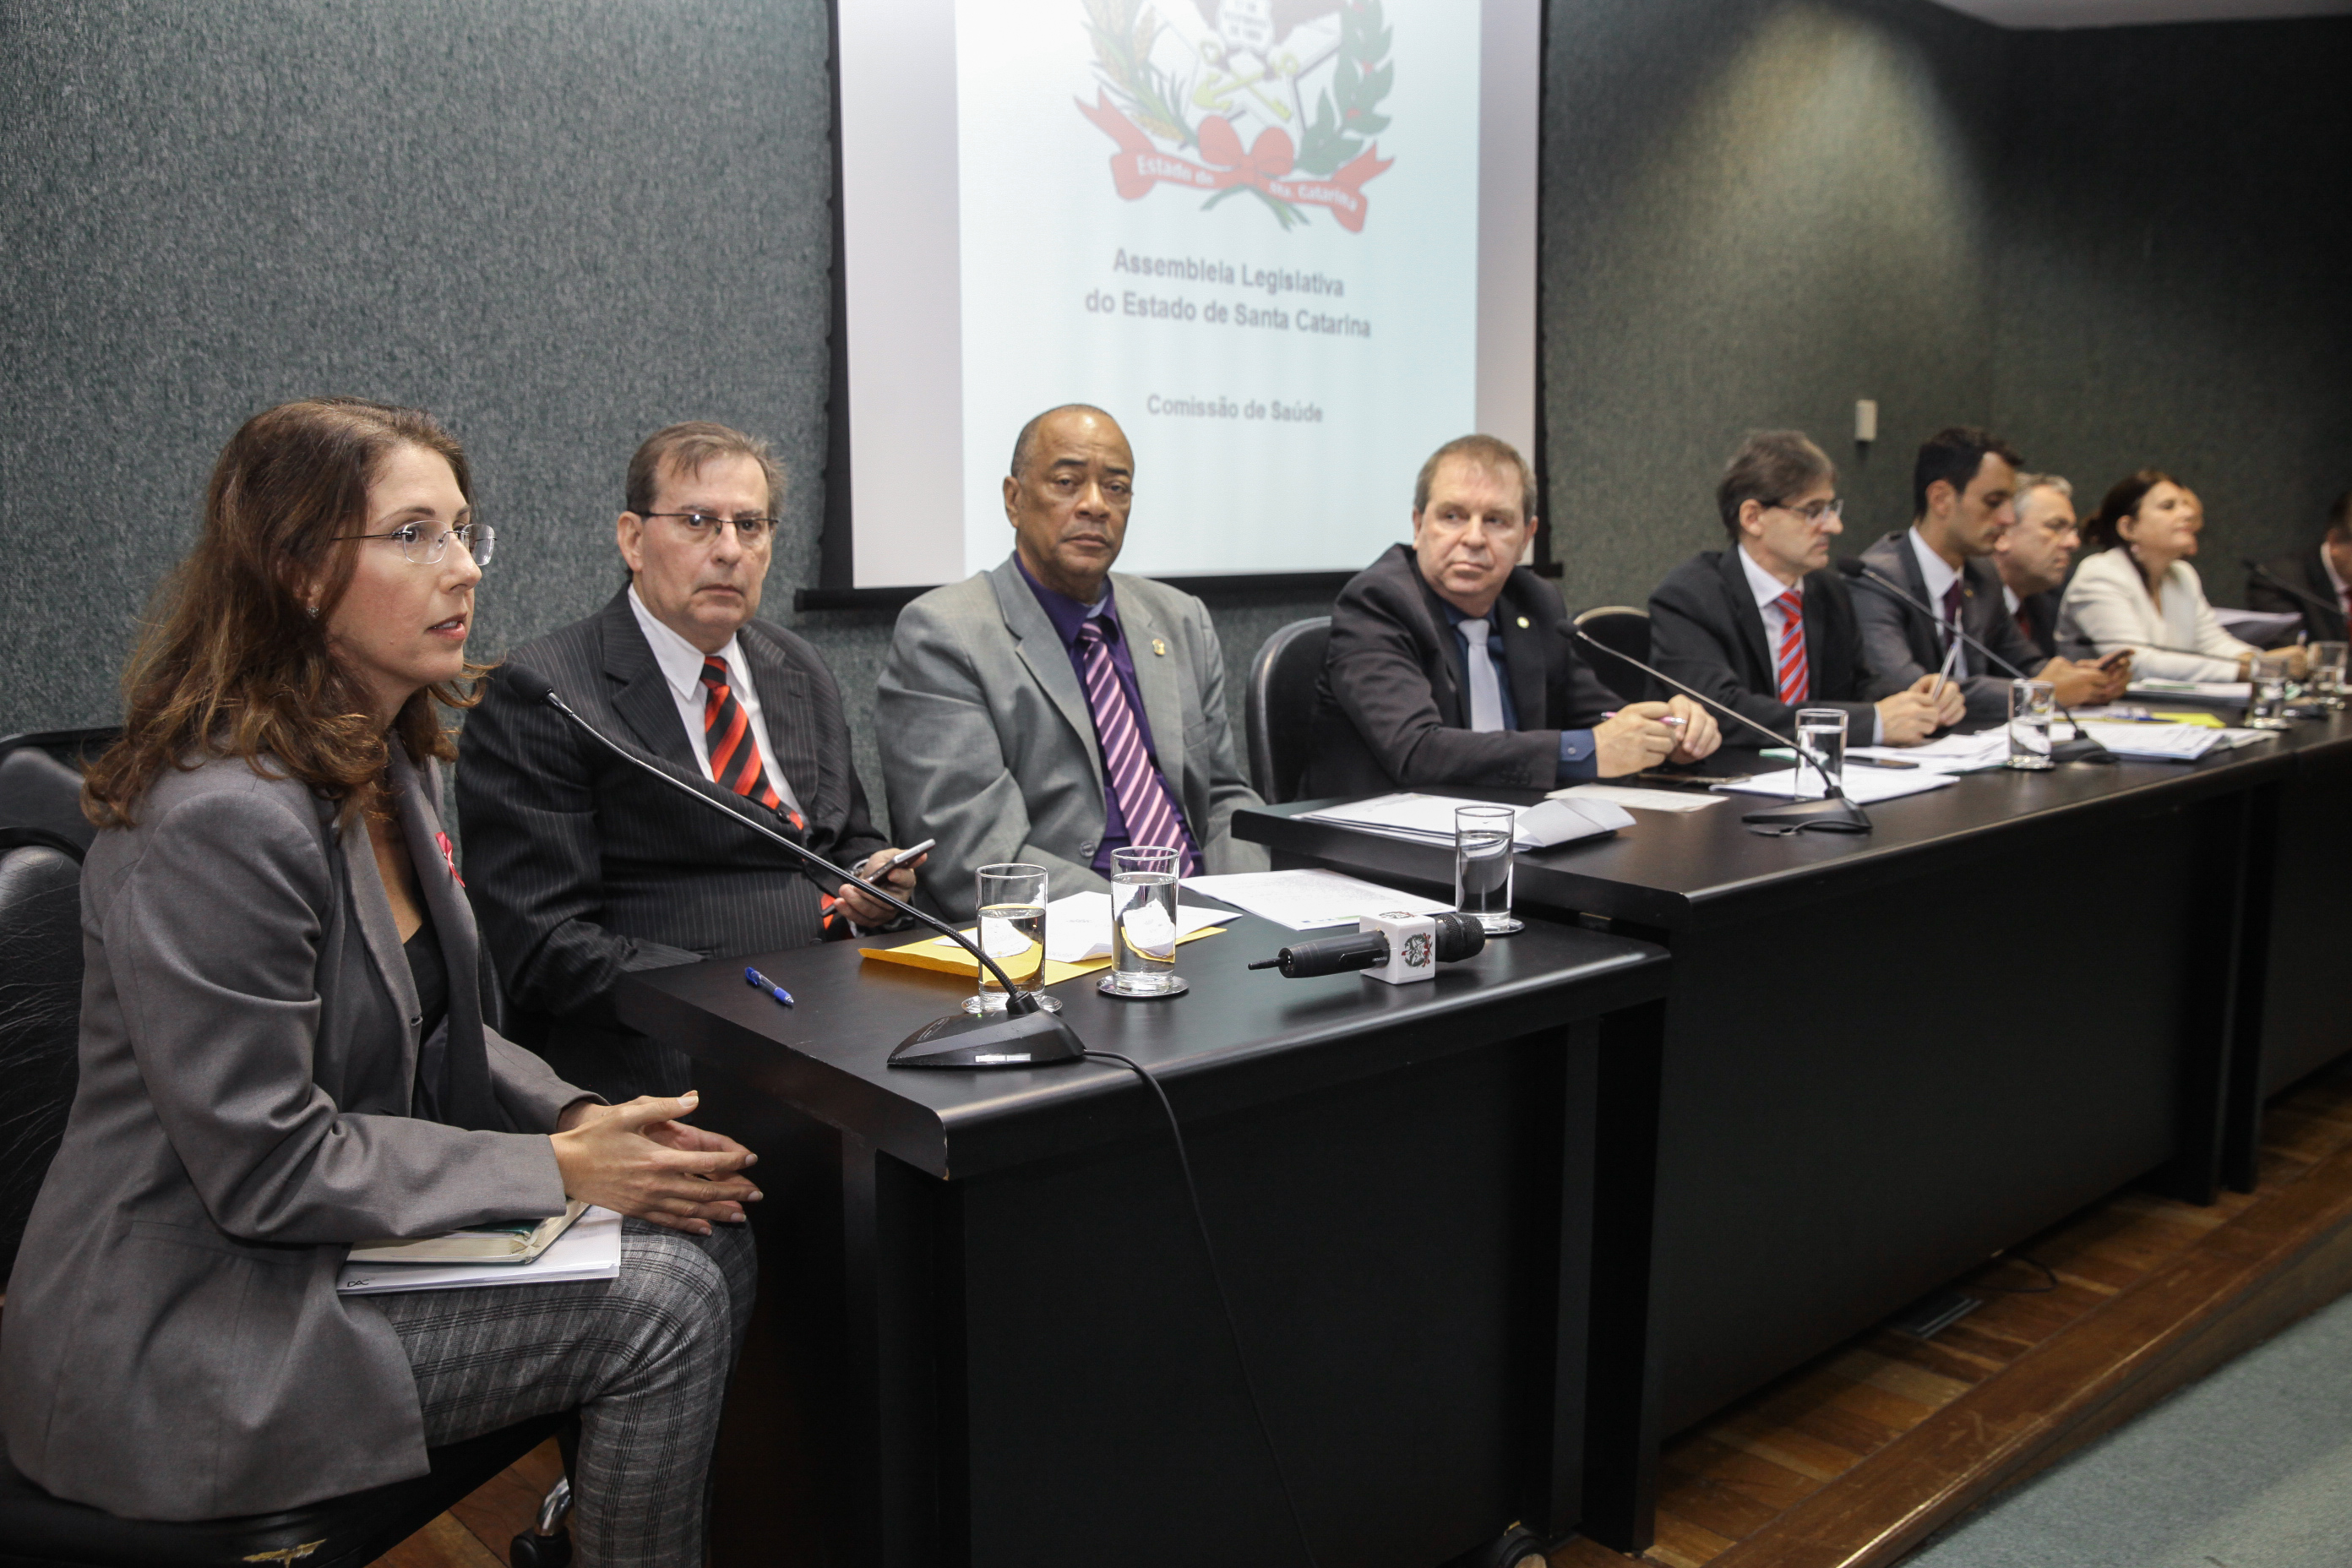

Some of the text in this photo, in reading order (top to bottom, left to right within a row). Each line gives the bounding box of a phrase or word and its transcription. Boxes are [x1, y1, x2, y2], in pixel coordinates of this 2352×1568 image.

[1136, 155, 1192, 181] Estado
[1298, 183, 1358, 212] Catarina
[1113, 248, 1345, 296] Assembleia Legislativa
[1085, 287, 1372, 338] do Estado de Santa Catarina
[1147, 393, 1323, 422] Comissão de Saúde
